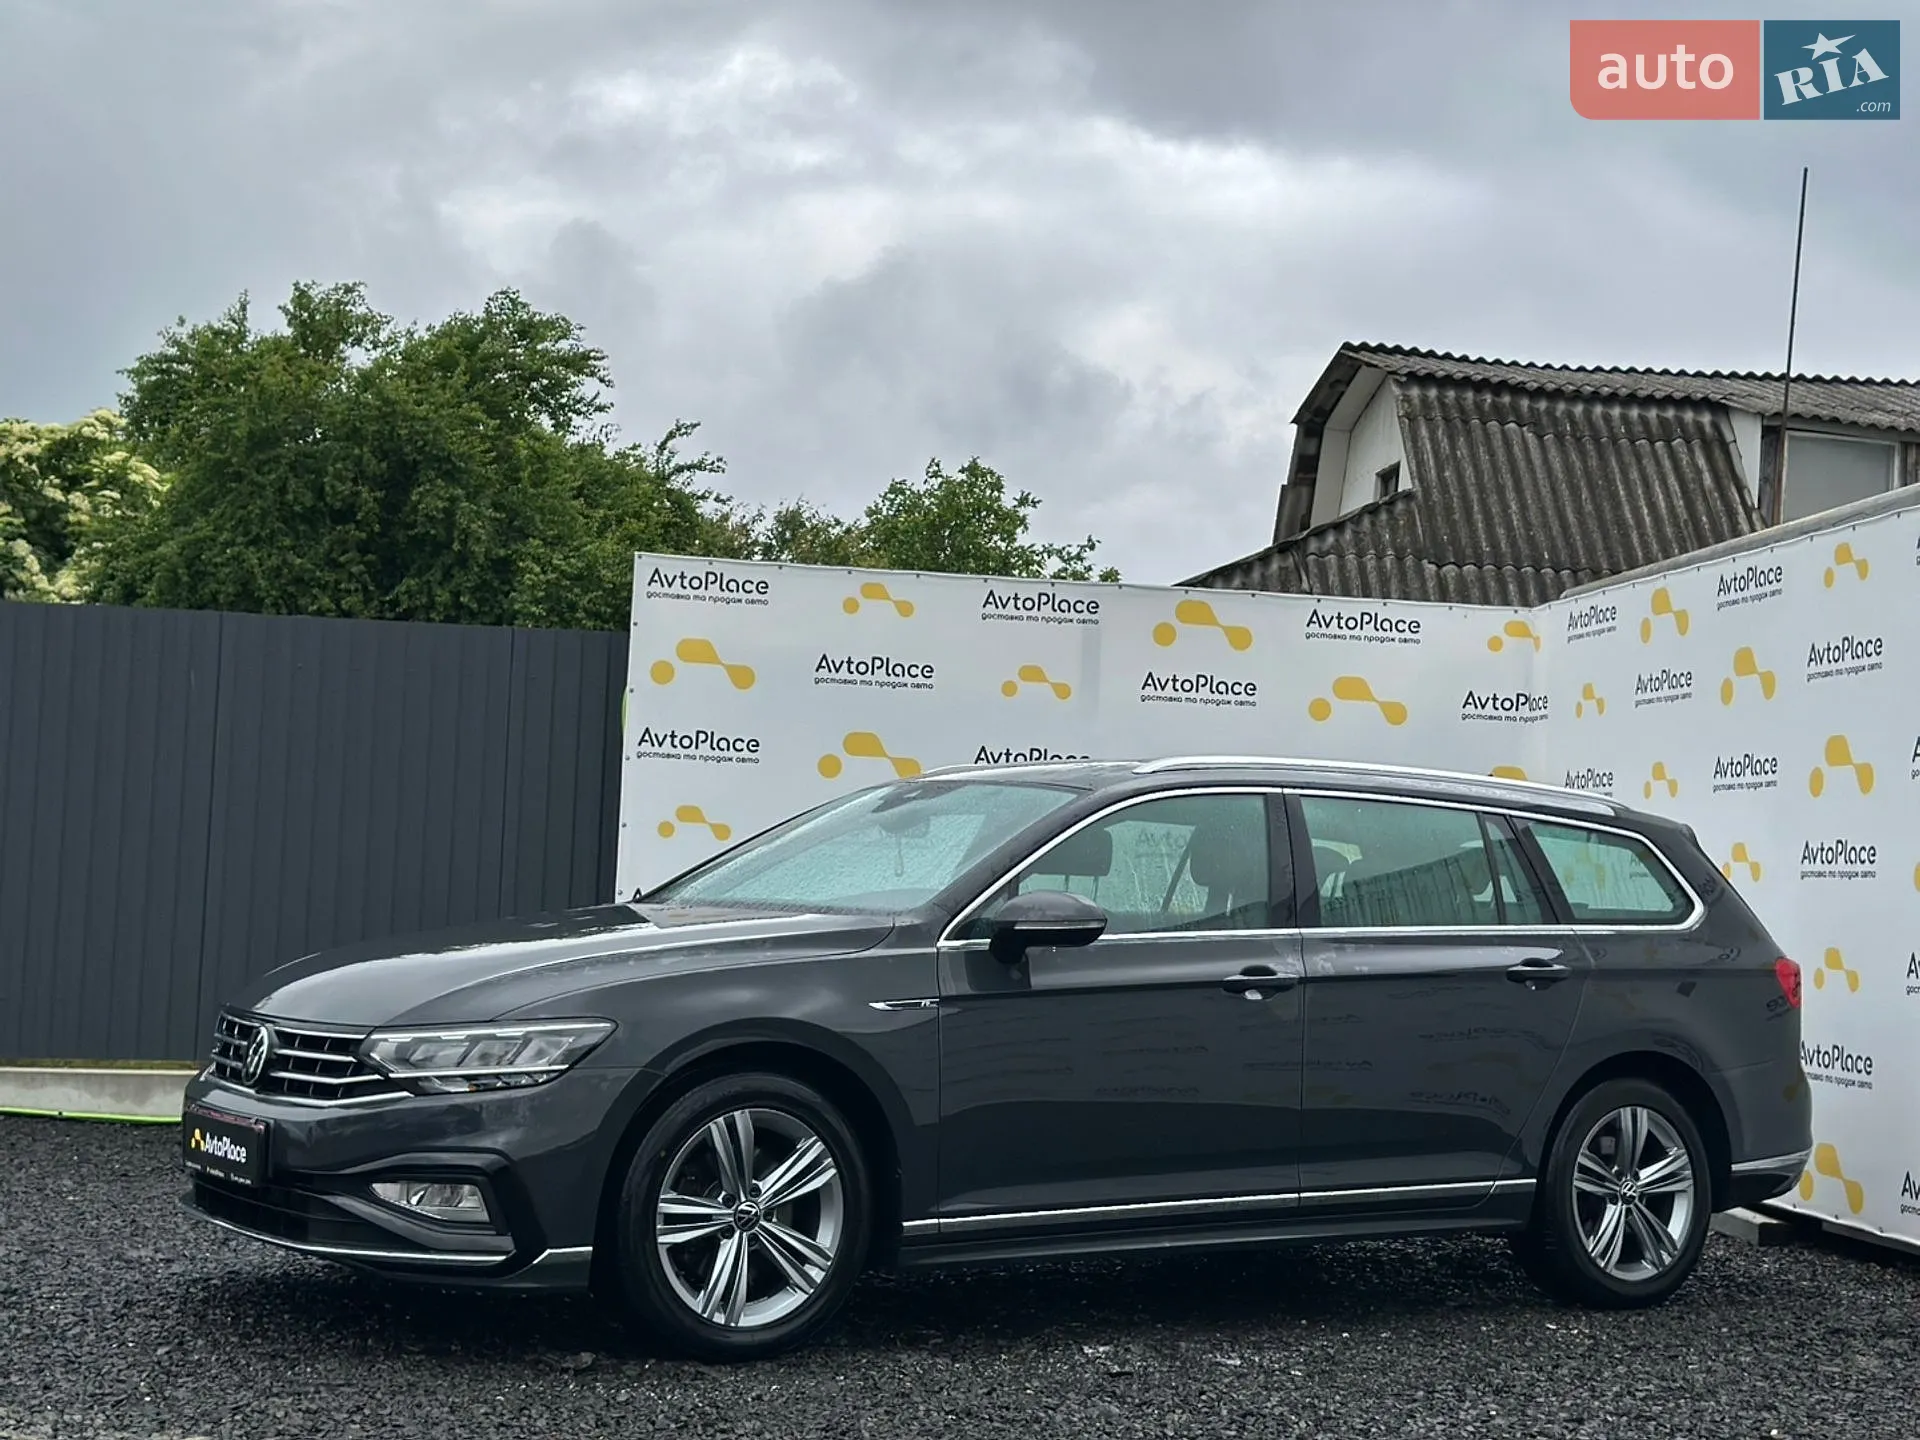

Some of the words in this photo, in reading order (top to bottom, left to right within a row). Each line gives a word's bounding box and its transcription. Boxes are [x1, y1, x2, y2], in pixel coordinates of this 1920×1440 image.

[648, 567, 769, 595] AvtoPlace
[1717, 565, 1783, 597] AvtoPlace
[646, 591, 691, 600] доставка
[692, 594, 706, 602] та
[708, 595, 742, 604] продаж
[744, 597, 769, 606] авто
[982, 589, 1100, 614] AvtoPlace
[1041, 616, 1074, 624] продаж
[1306, 608, 1421, 634] AvtoPlace
[1567, 604, 1617, 631] AvtoPlace
[1305, 632, 1347, 640] доставка
[1364, 636, 1396, 644] продаж
[1398, 637, 1421, 645] авто
[1807, 635, 1883, 667] AvtoPlace
[815, 653, 934, 678] AvtoPlace
[814, 677, 858, 685] доставка
[875, 680, 908, 689] продаж
[1141, 671, 1257, 696] AvtoPlace
[1635, 668, 1692, 695] AvtoPlace
[1199, 698, 1232, 706] продаж
[1462, 690, 1548, 712] AvtoPlace
[638, 727, 760, 753] AvtoPlace
[637, 751, 681, 759] доставка
[699, 755, 733, 763] продаж
[974, 745, 1090, 764] AvtoPl
[1713, 753, 1778, 779] AvtoPlace
[1565, 768, 1613, 789] AvtoPlace
[1801, 839, 1876, 865] AvtoPlace
[1801, 1039, 1873, 1076] AvtoPlace
[204, 1131, 247, 1163] AvtoPlace
